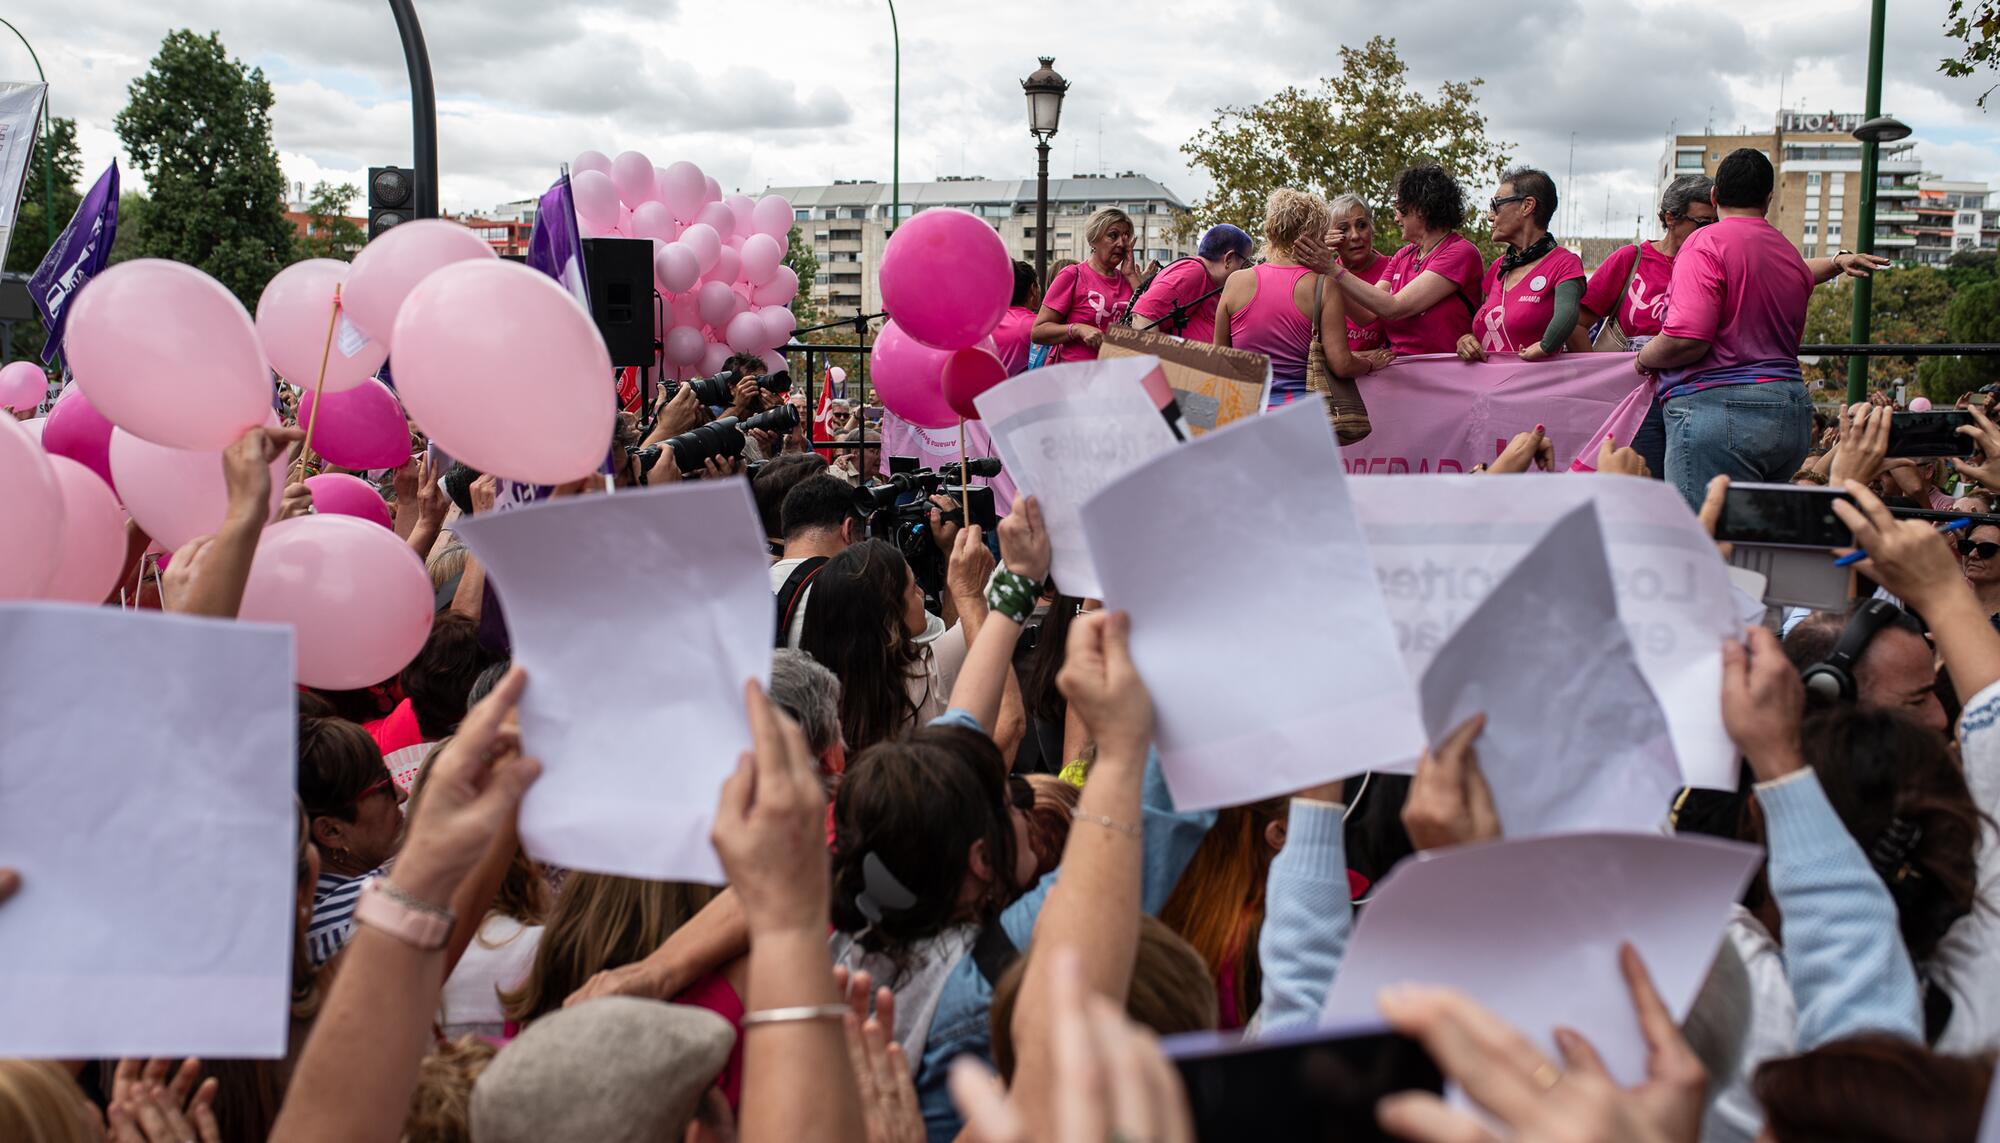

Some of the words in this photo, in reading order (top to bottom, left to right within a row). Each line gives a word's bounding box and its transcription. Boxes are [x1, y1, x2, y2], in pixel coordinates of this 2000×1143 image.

[1108, 326, 1138, 341] cada
[1139, 333, 1156, 346] de
[914, 426, 931, 446] Sevill
[930, 440, 957, 448] Amama
